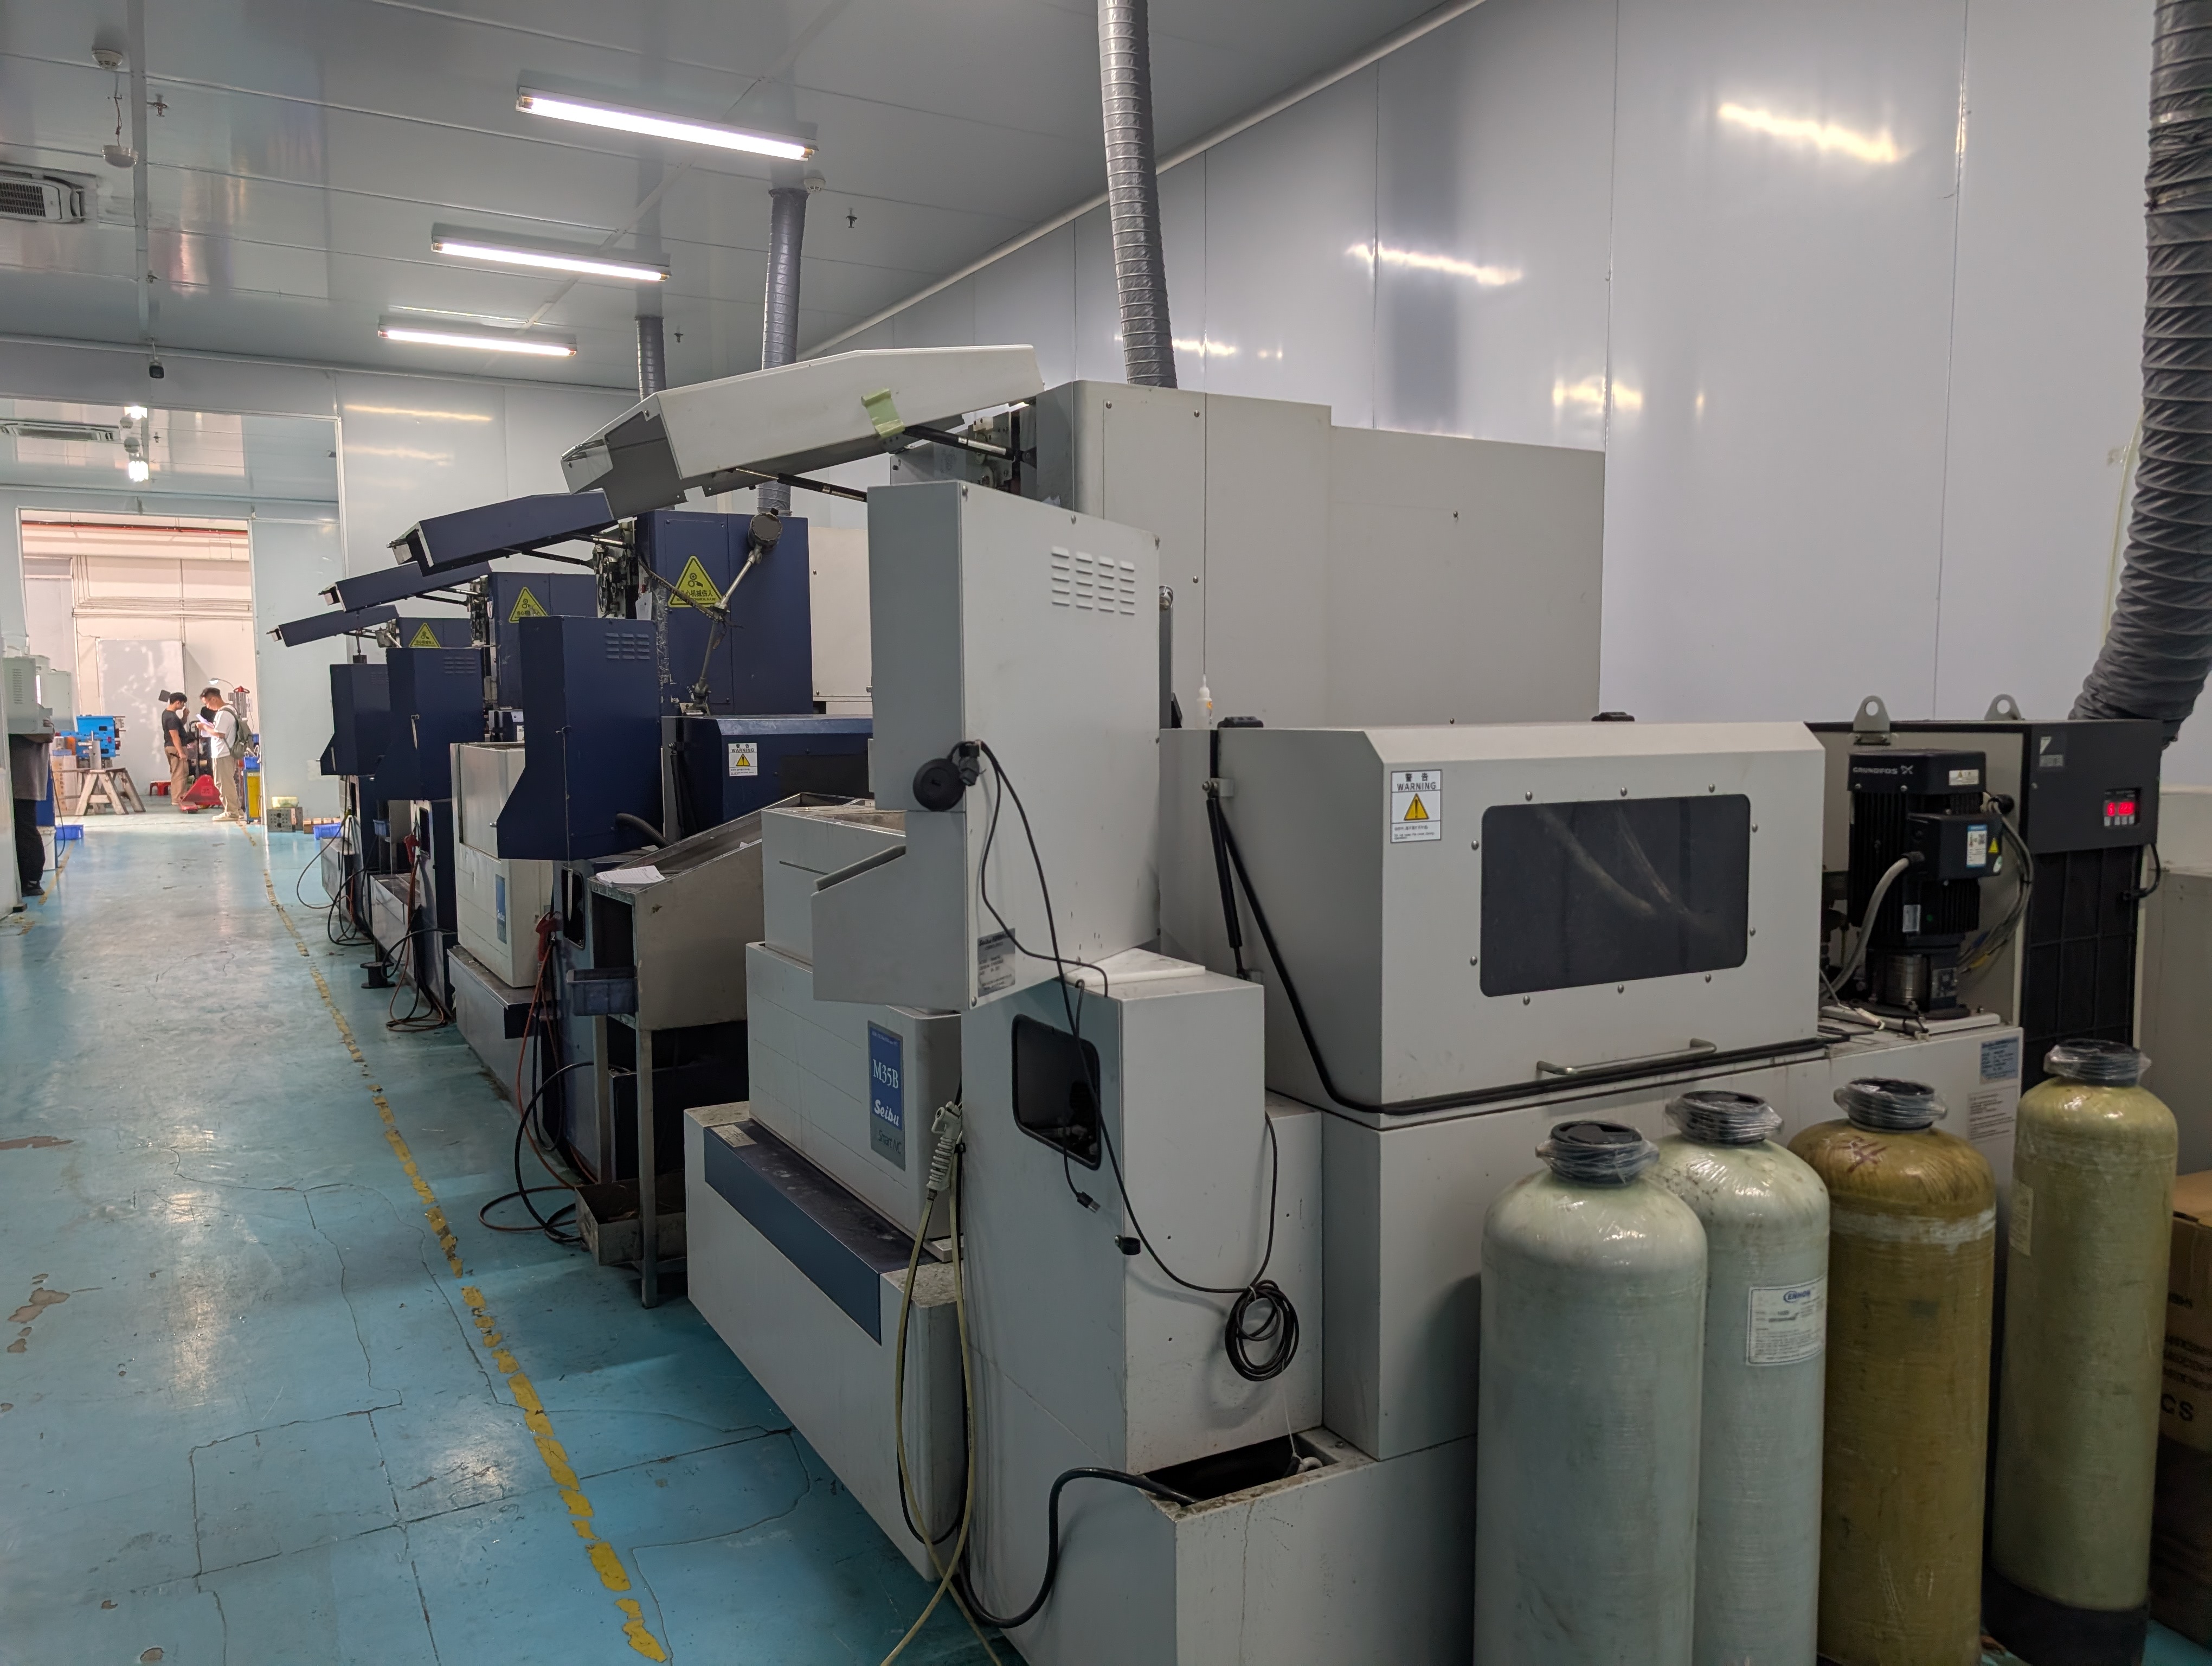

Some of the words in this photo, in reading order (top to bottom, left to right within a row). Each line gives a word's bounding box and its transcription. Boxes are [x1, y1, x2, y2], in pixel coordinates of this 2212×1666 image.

[1397, 781, 1437, 791] WARNING
[872, 1059, 899, 1089] M35B
[874, 1099, 900, 1126] Seibu
[893, 1138, 902, 1155] NC
